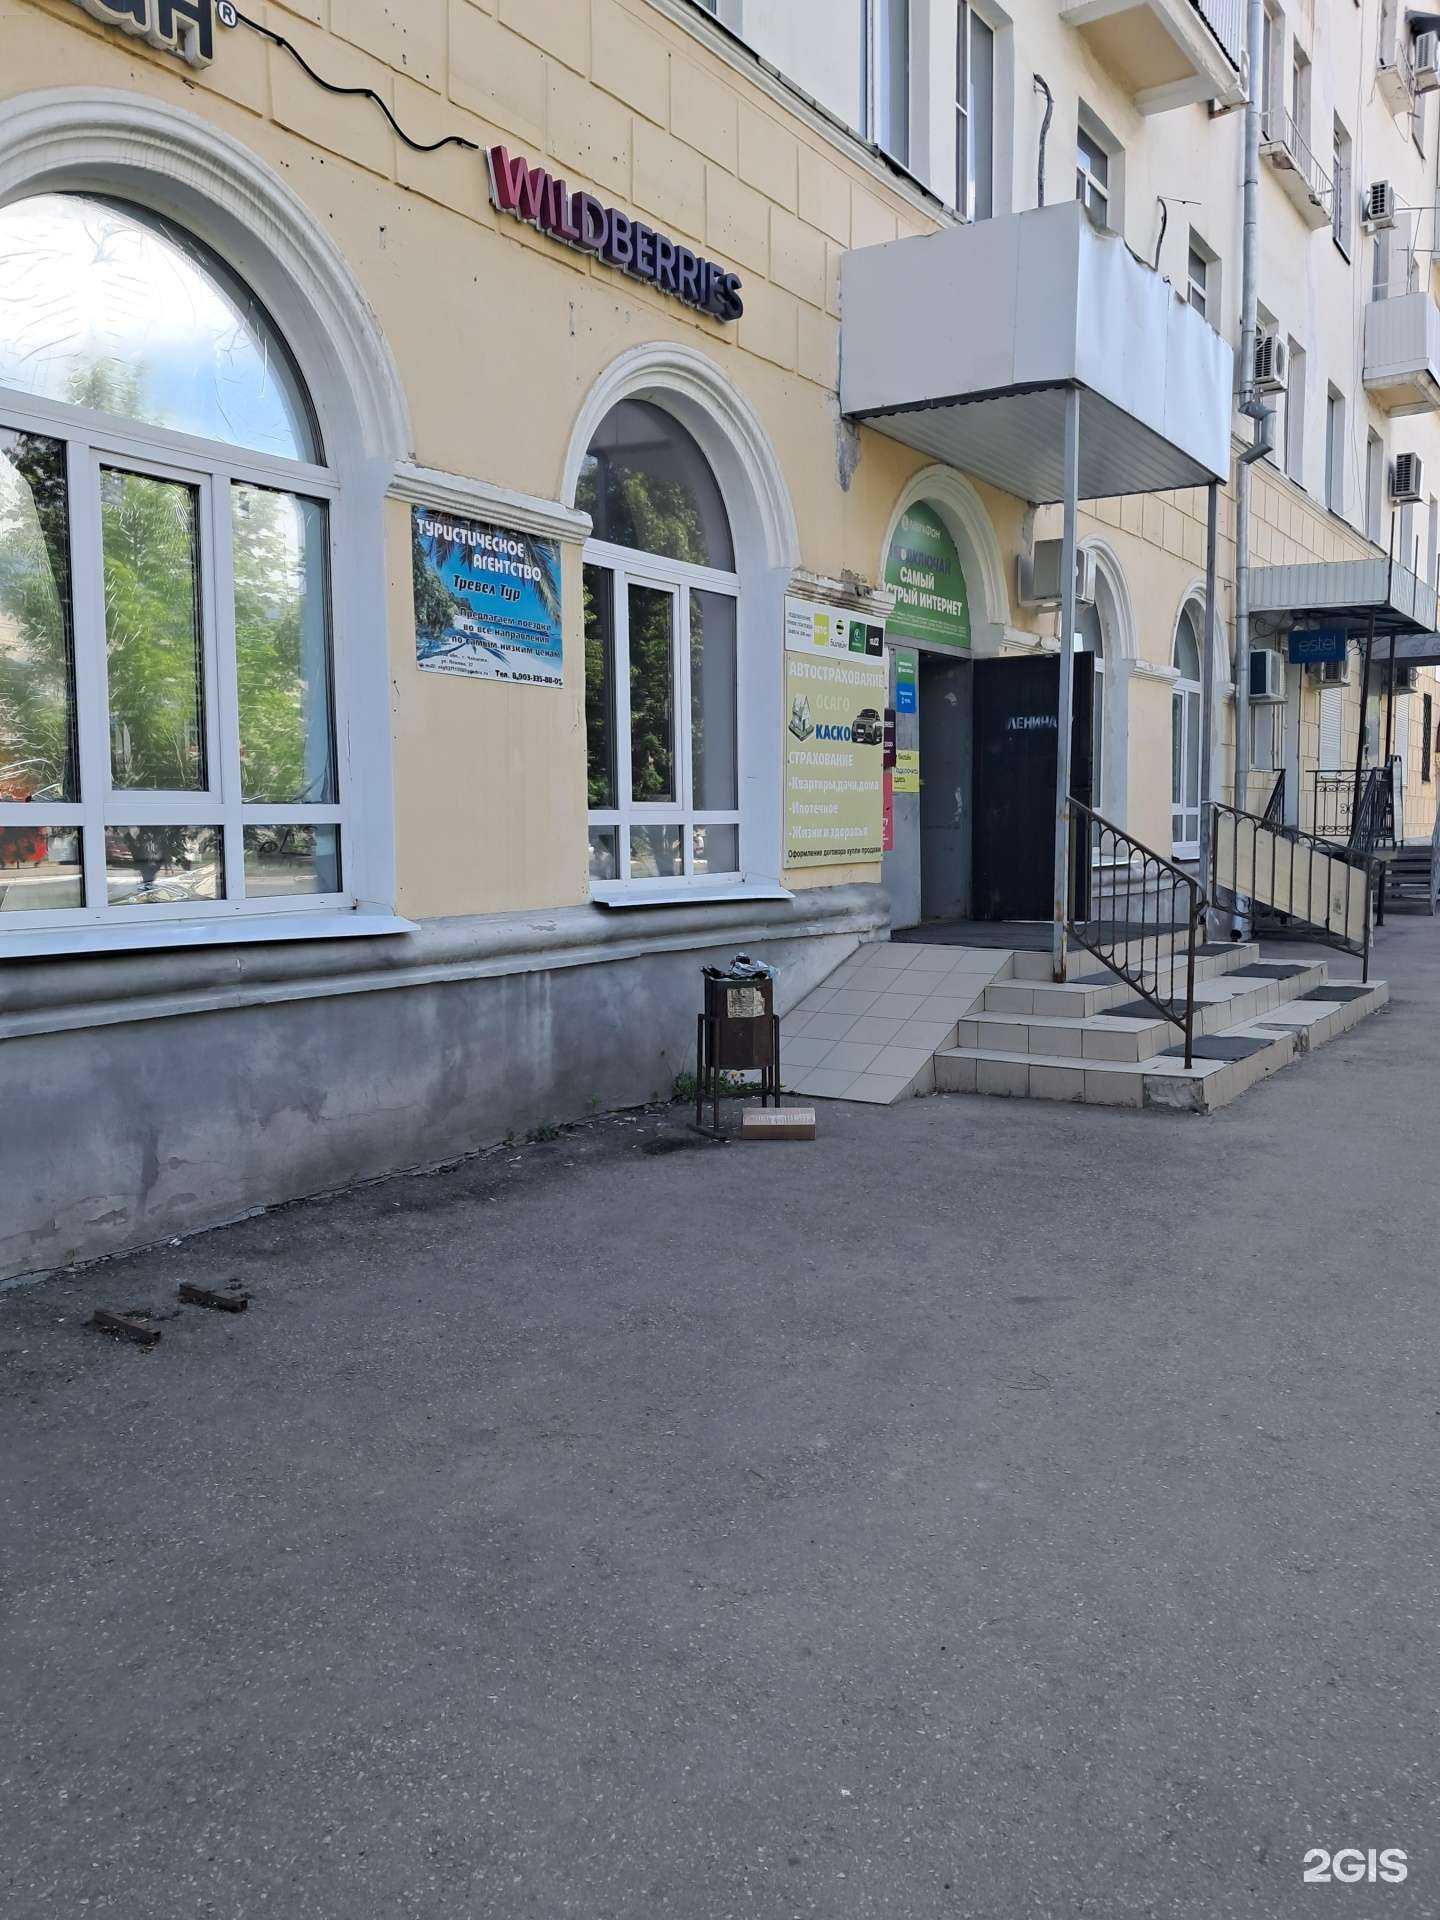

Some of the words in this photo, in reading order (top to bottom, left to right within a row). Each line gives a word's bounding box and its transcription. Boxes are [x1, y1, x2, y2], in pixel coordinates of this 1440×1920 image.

[485, 144, 745, 324] WILDBERRIES
[416, 518, 525, 558] ТУРИСТИЧЕСКОЕ
[473, 554, 542, 582] АГЕНТСТВО
[900, 565, 935, 591] САМЫЙ
[453, 574, 496, 595] Тревел
[500, 584, 521, 602] Тур
[919, 592, 963, 617] ИНТЕРНЕТ
[460, 607, 515, 625] Предлагаем
[451, 635, 463, 644] по
[494, 669, 511, 679] Тел.
[815, 694, 851, 712] ОСАГО
[815, 723, 851, 742] КАСКО
[789, 751, 854, 768] СТРАХОВАНИЕ
